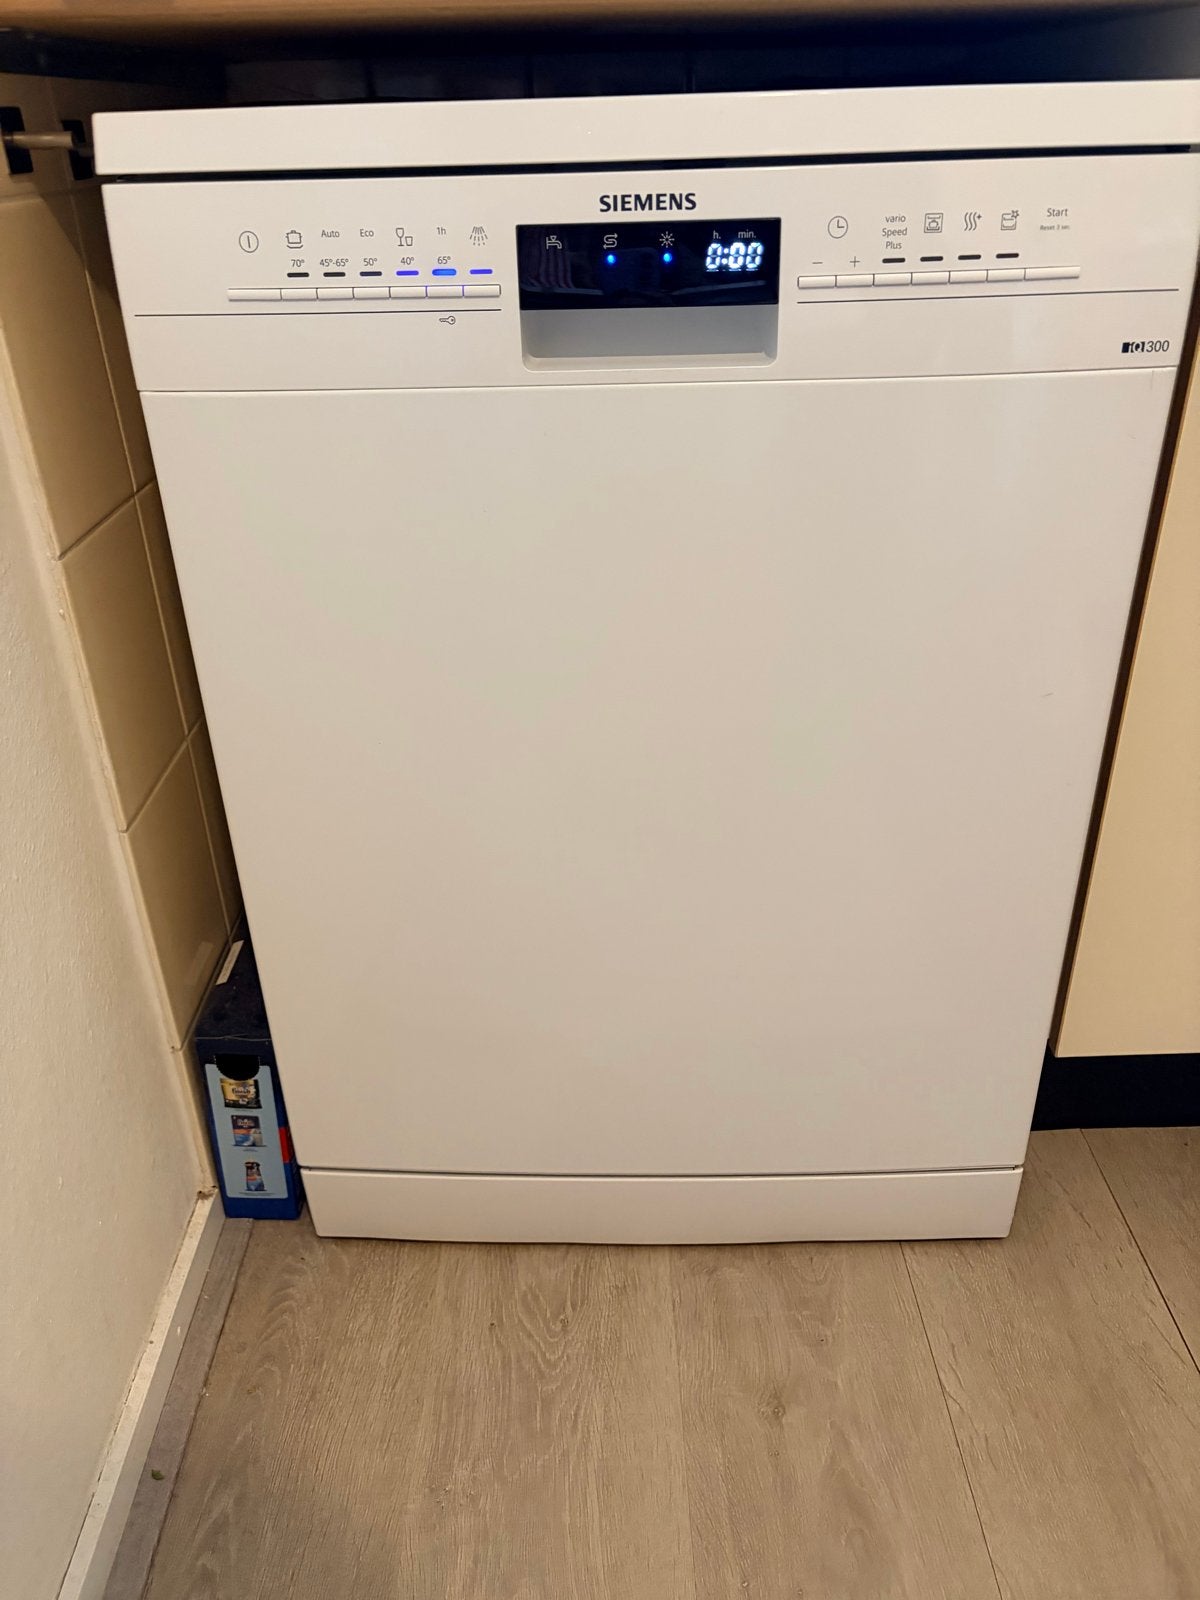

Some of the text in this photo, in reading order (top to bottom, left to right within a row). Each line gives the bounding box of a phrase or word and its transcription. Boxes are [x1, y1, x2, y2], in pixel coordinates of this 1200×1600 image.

[599, 193, 696, 212] SIEMENS
[1047, 207, 1068, 217] Start
[885, 213, 906, 223] vario
[321, 229, 340, 238] Auto
[360, 228, 375, 237] Eco
[437, 226, 447, 235] 1h
[738, 230, 757, 239] min.
[882, 227, 908, 237] Speed
[886, 241, 902, 249] Plus
[438, 255, 452, 265] 65°
[706, 242, 763, 269] 0:00
[291, 259, 305, 267] 70°
[363, 257, 378, 266] 50°
[400, 256, 415, 265] 40°
